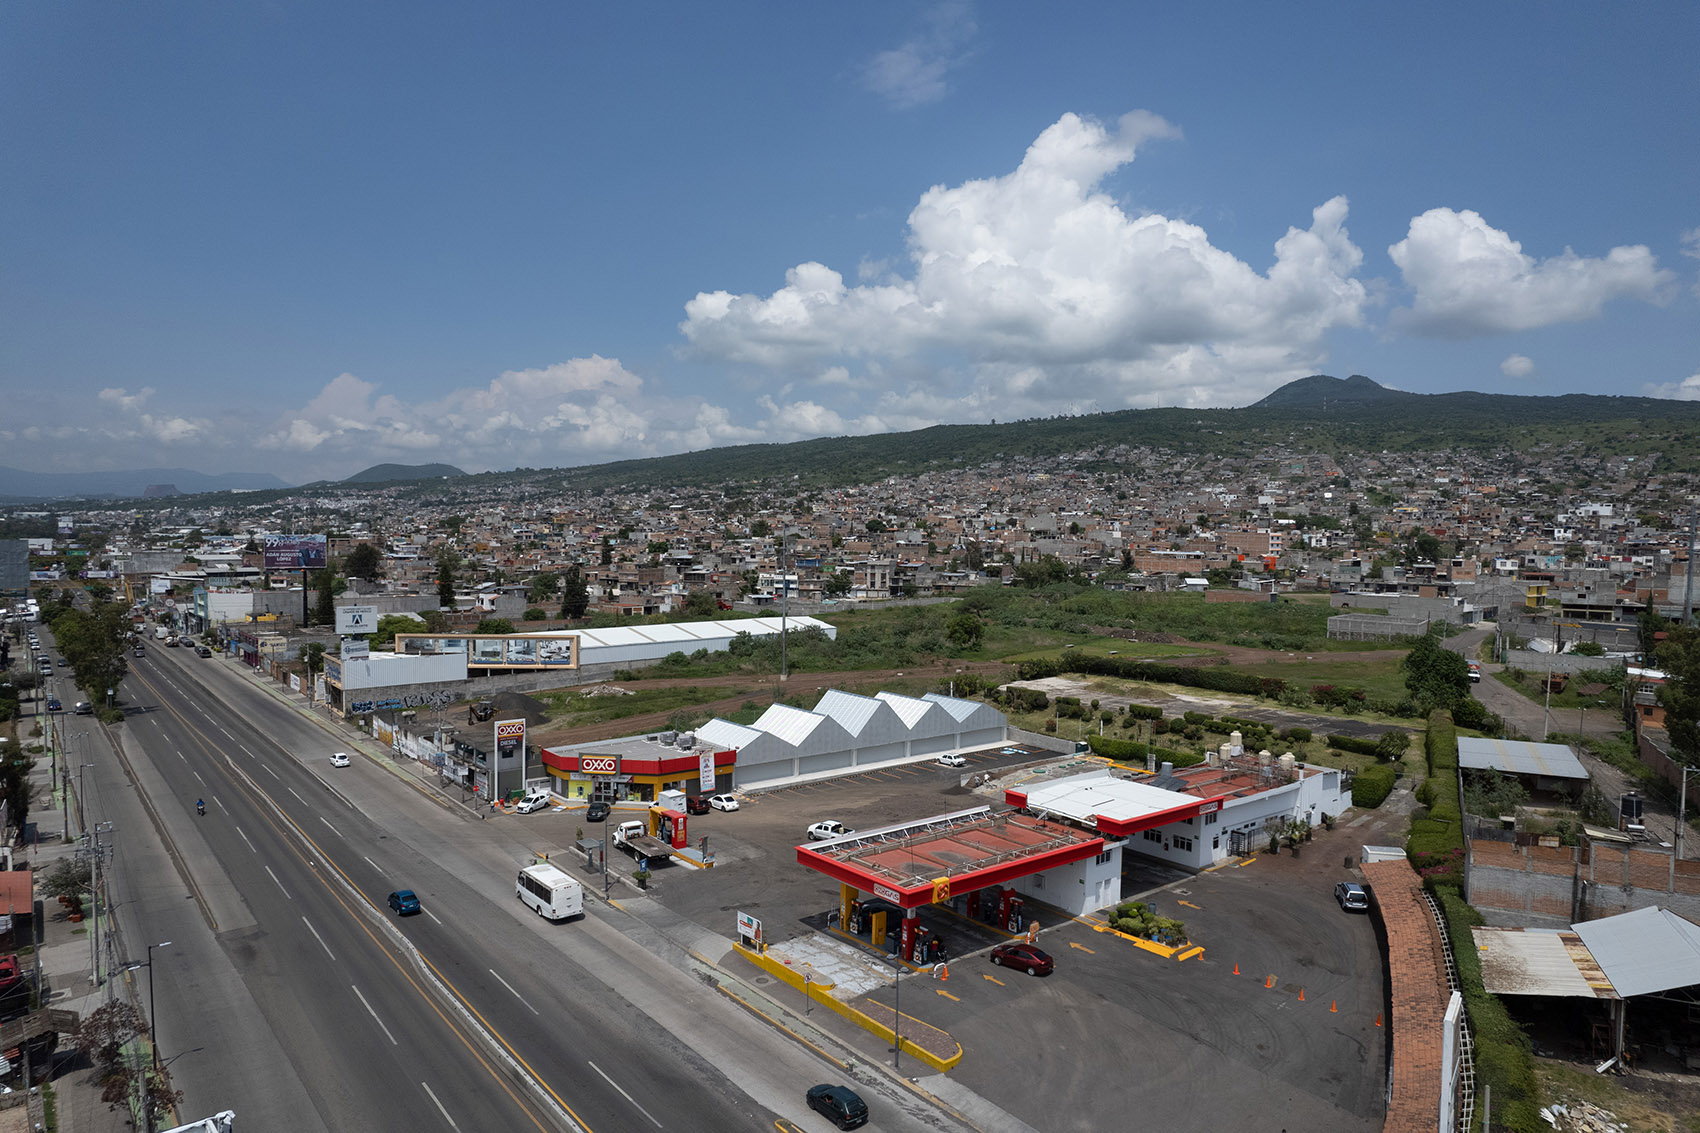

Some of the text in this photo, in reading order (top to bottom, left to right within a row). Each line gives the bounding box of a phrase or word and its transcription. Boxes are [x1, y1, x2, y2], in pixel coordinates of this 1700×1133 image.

[265, 537, 279, 547] 99
[498, 723, 524, 735] OXXO
[583, 758, 615, 771] OXXO
